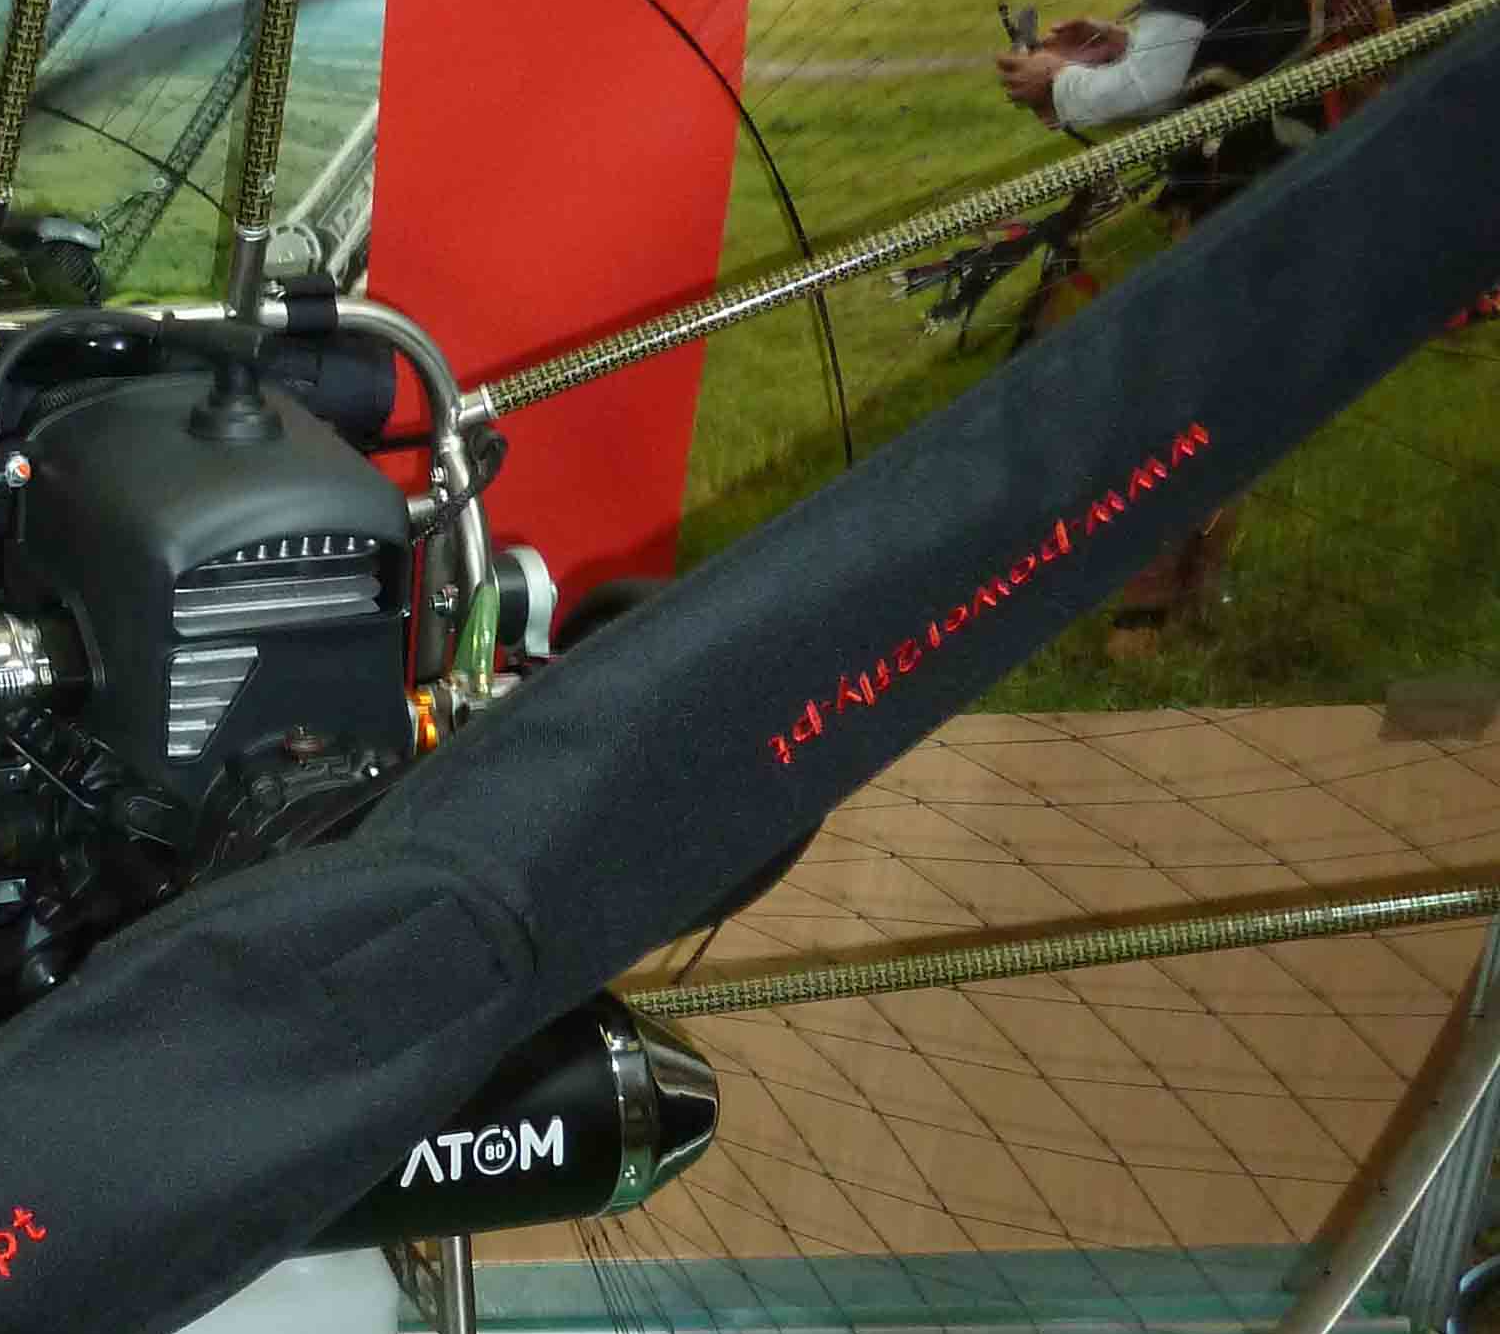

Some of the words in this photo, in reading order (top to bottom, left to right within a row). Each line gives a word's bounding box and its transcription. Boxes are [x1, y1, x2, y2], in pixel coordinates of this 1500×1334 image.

[767, 421, 1211, 765] www.power2fly.pt
[400, 1115, 564, 1188] ATOM
[484, 1144, 506, 1161] 80
